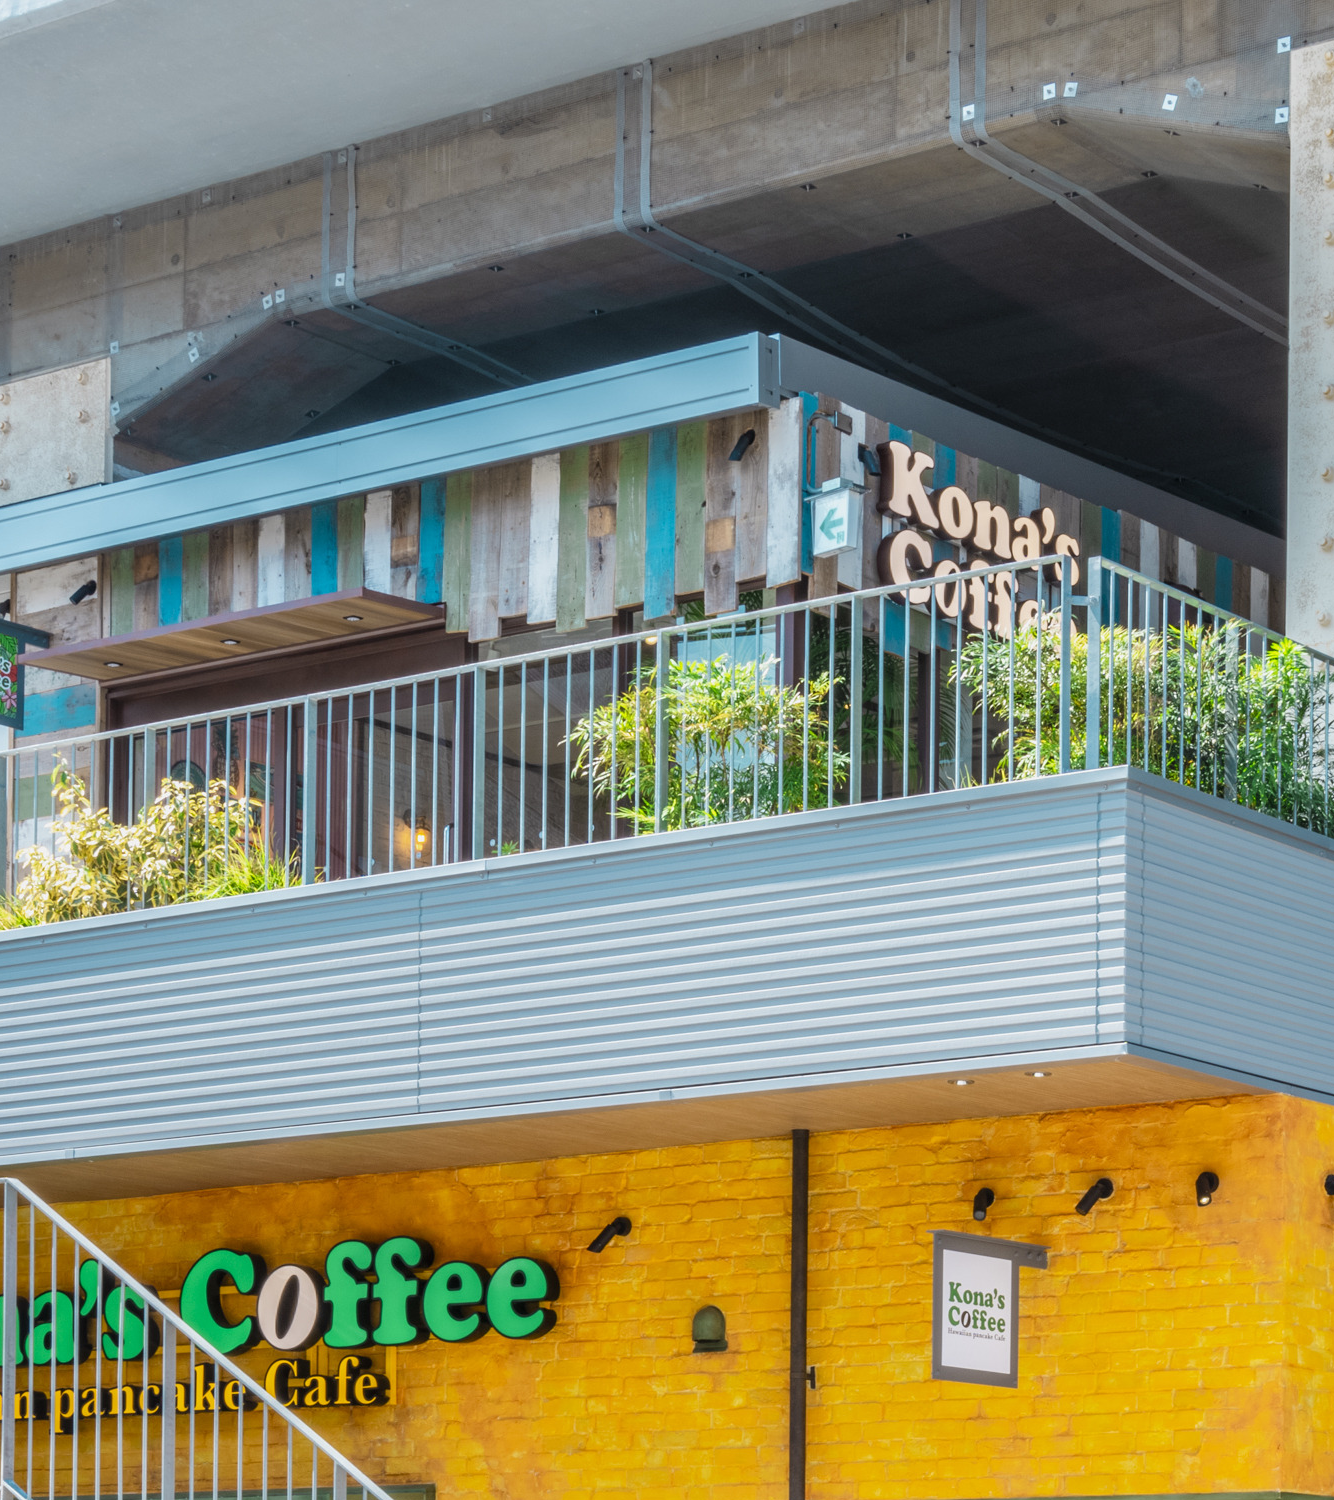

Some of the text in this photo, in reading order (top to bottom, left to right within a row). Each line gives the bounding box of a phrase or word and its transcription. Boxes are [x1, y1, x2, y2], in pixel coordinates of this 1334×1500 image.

[881, 440, 1080, 587] Kona's
[880, 529, 1077, 650] Coffe
[179, 1236, 550, 1354] Coffee
[948, 1281, 1006, 1309] Kona's
[948, 1305, 1006, 1333] Coffee
[50, 1364, 247, 1434] pancake
[265, 1356, 379, 1406] Cafe
